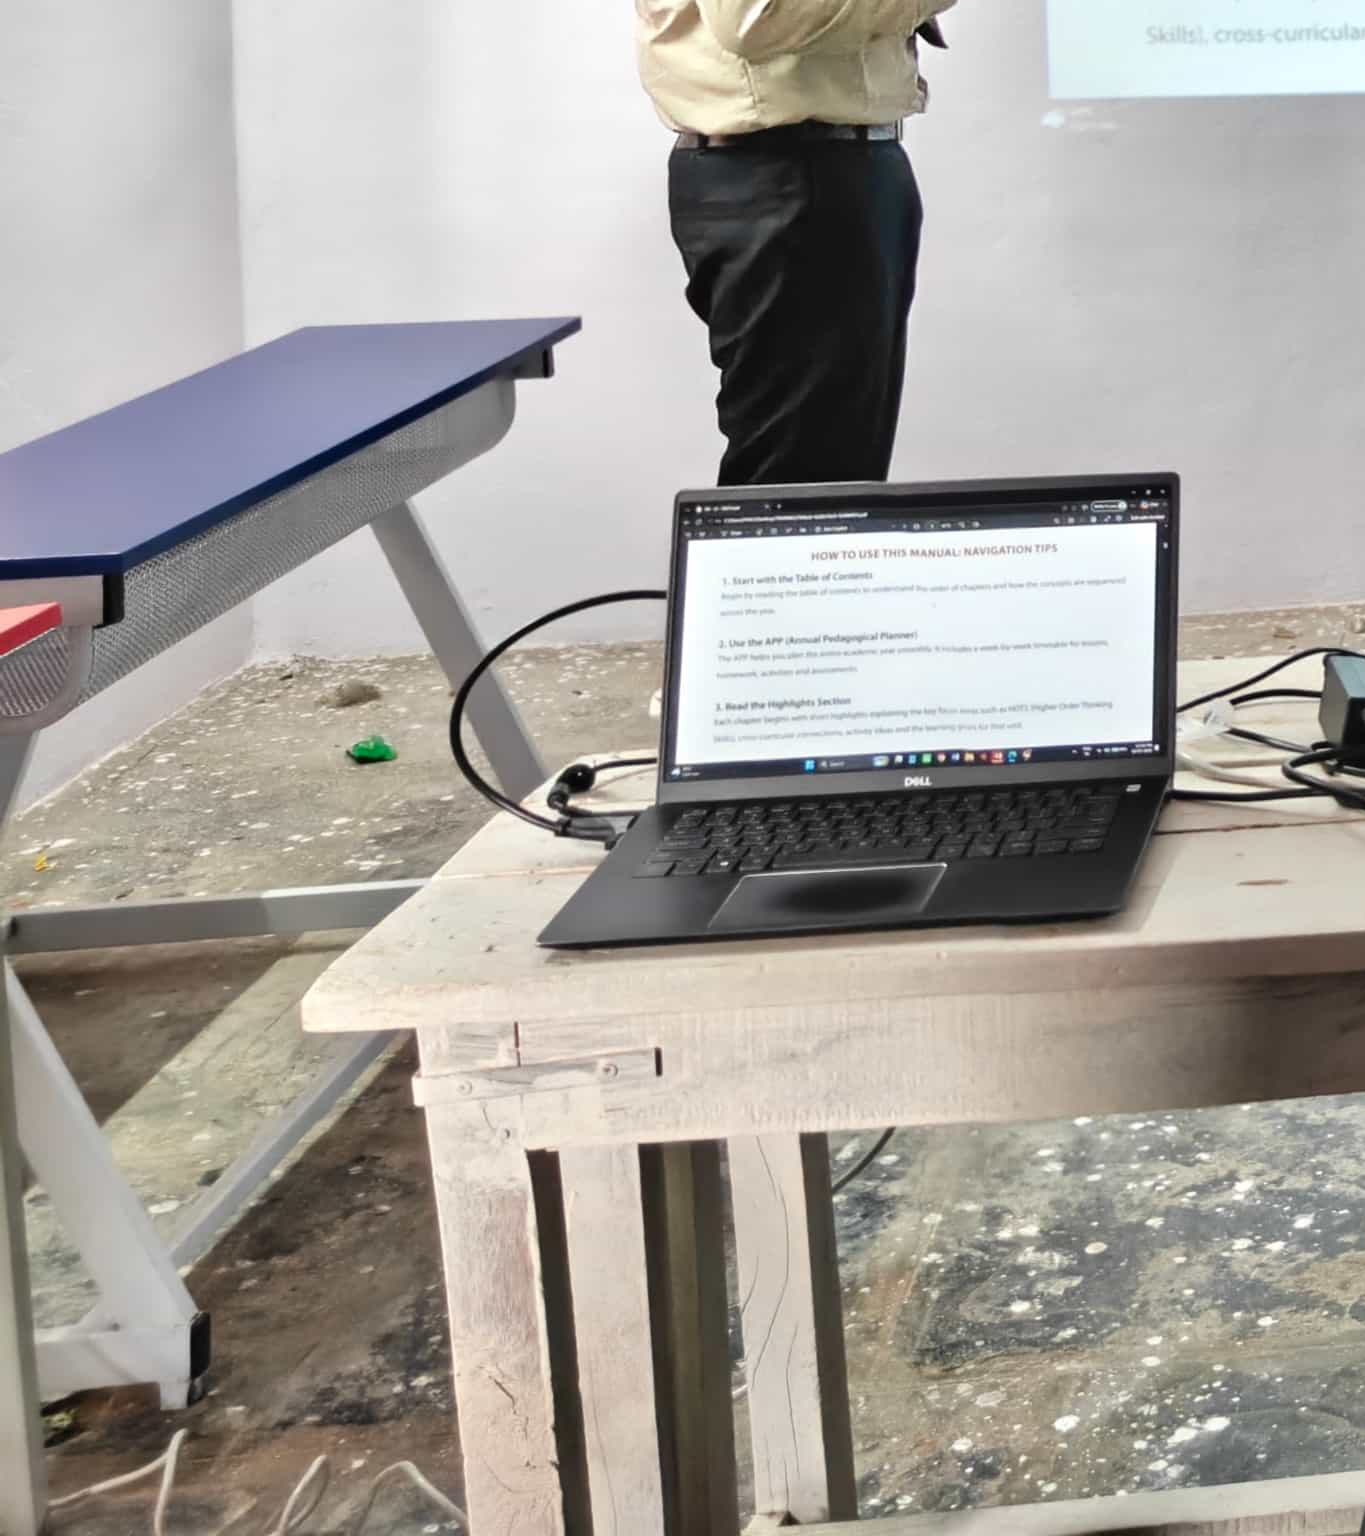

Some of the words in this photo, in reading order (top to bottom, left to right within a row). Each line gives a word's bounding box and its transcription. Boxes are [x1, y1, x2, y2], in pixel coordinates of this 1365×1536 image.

[811, 550, 840, 560] HOW
[841, 550, 857, 559] TO
[859, 549, 881, 559] USE
[882, 548, 908, 558] THIS
[910, 545, 962, 557] MANUAL:
[964, 543, 1033, 555] NAVIGATION
[1034, 542, 1058, 552] TIPS
[903, 775, 933, 789] DELL
